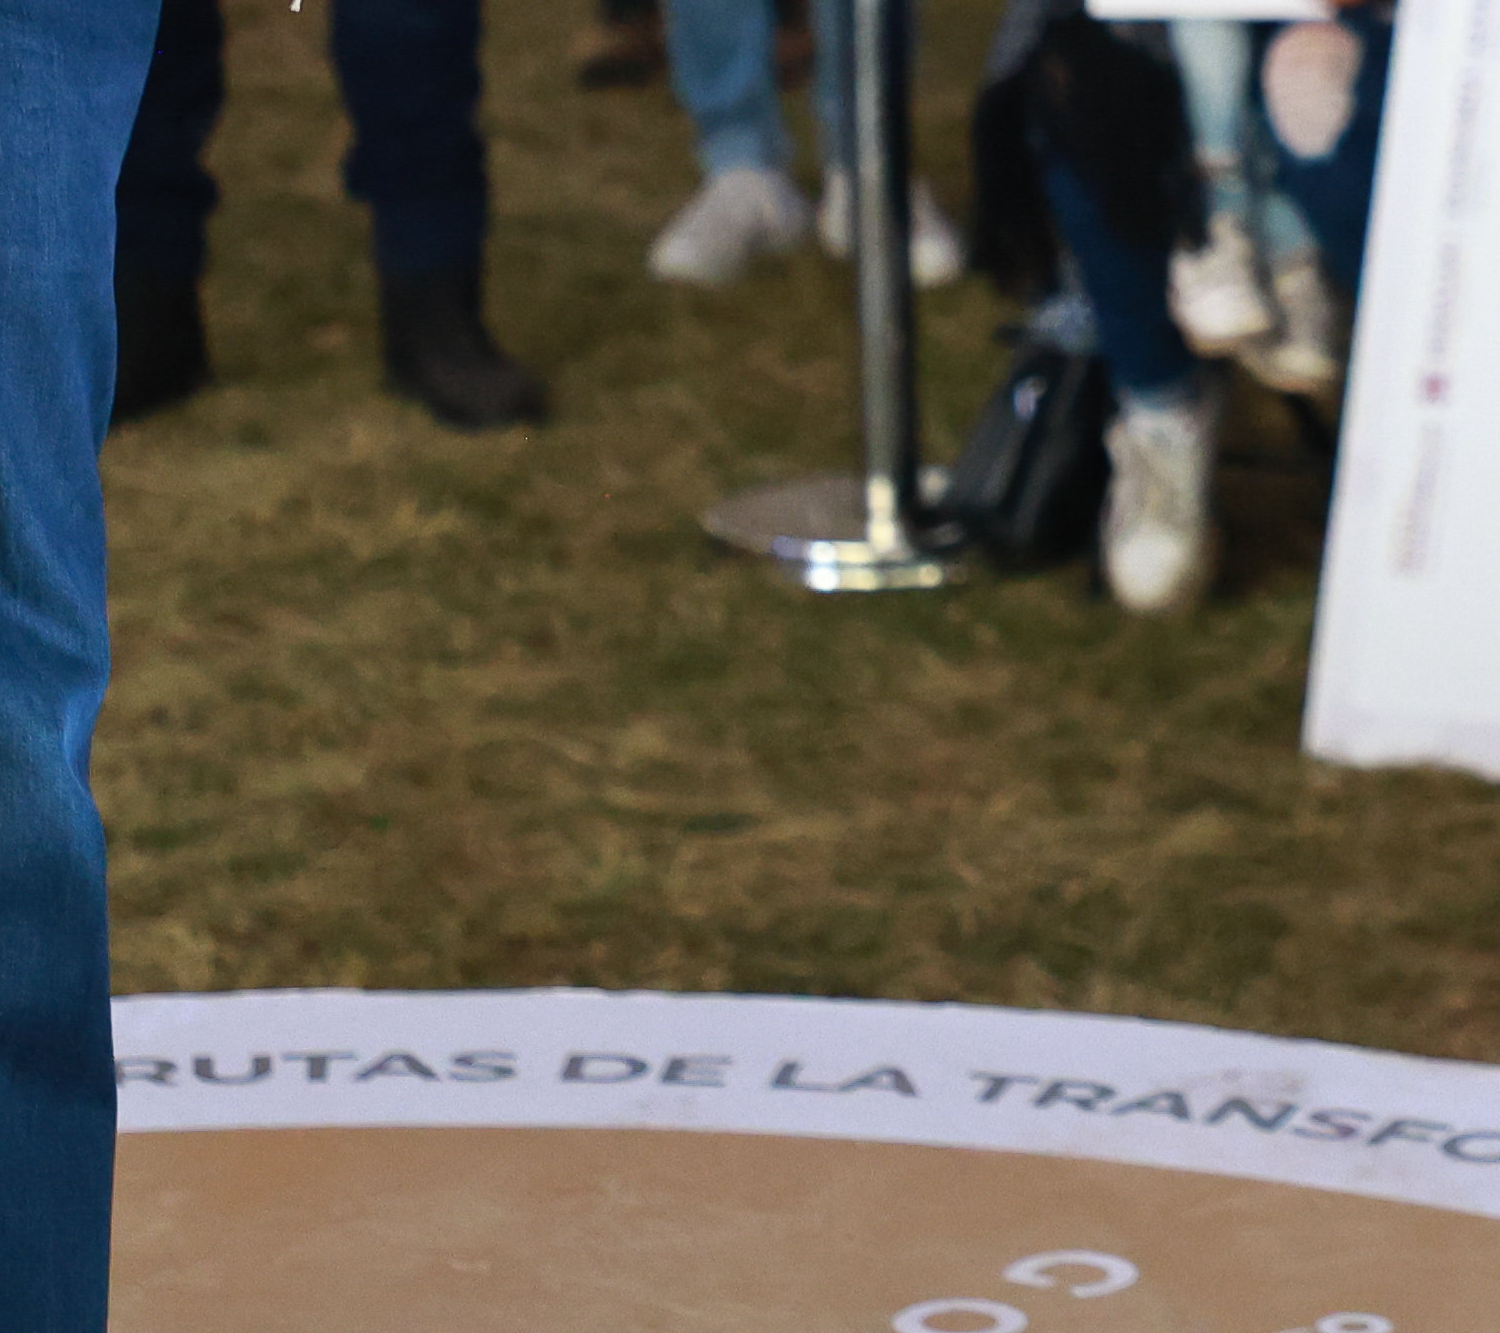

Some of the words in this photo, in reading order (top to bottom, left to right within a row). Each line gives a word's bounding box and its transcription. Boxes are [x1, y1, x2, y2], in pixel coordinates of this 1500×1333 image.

[115, 1050, 517, 1087] RUTAS
[561, 1052, 734, 1086] DE
[771, 1058, 919, 1098] LA
